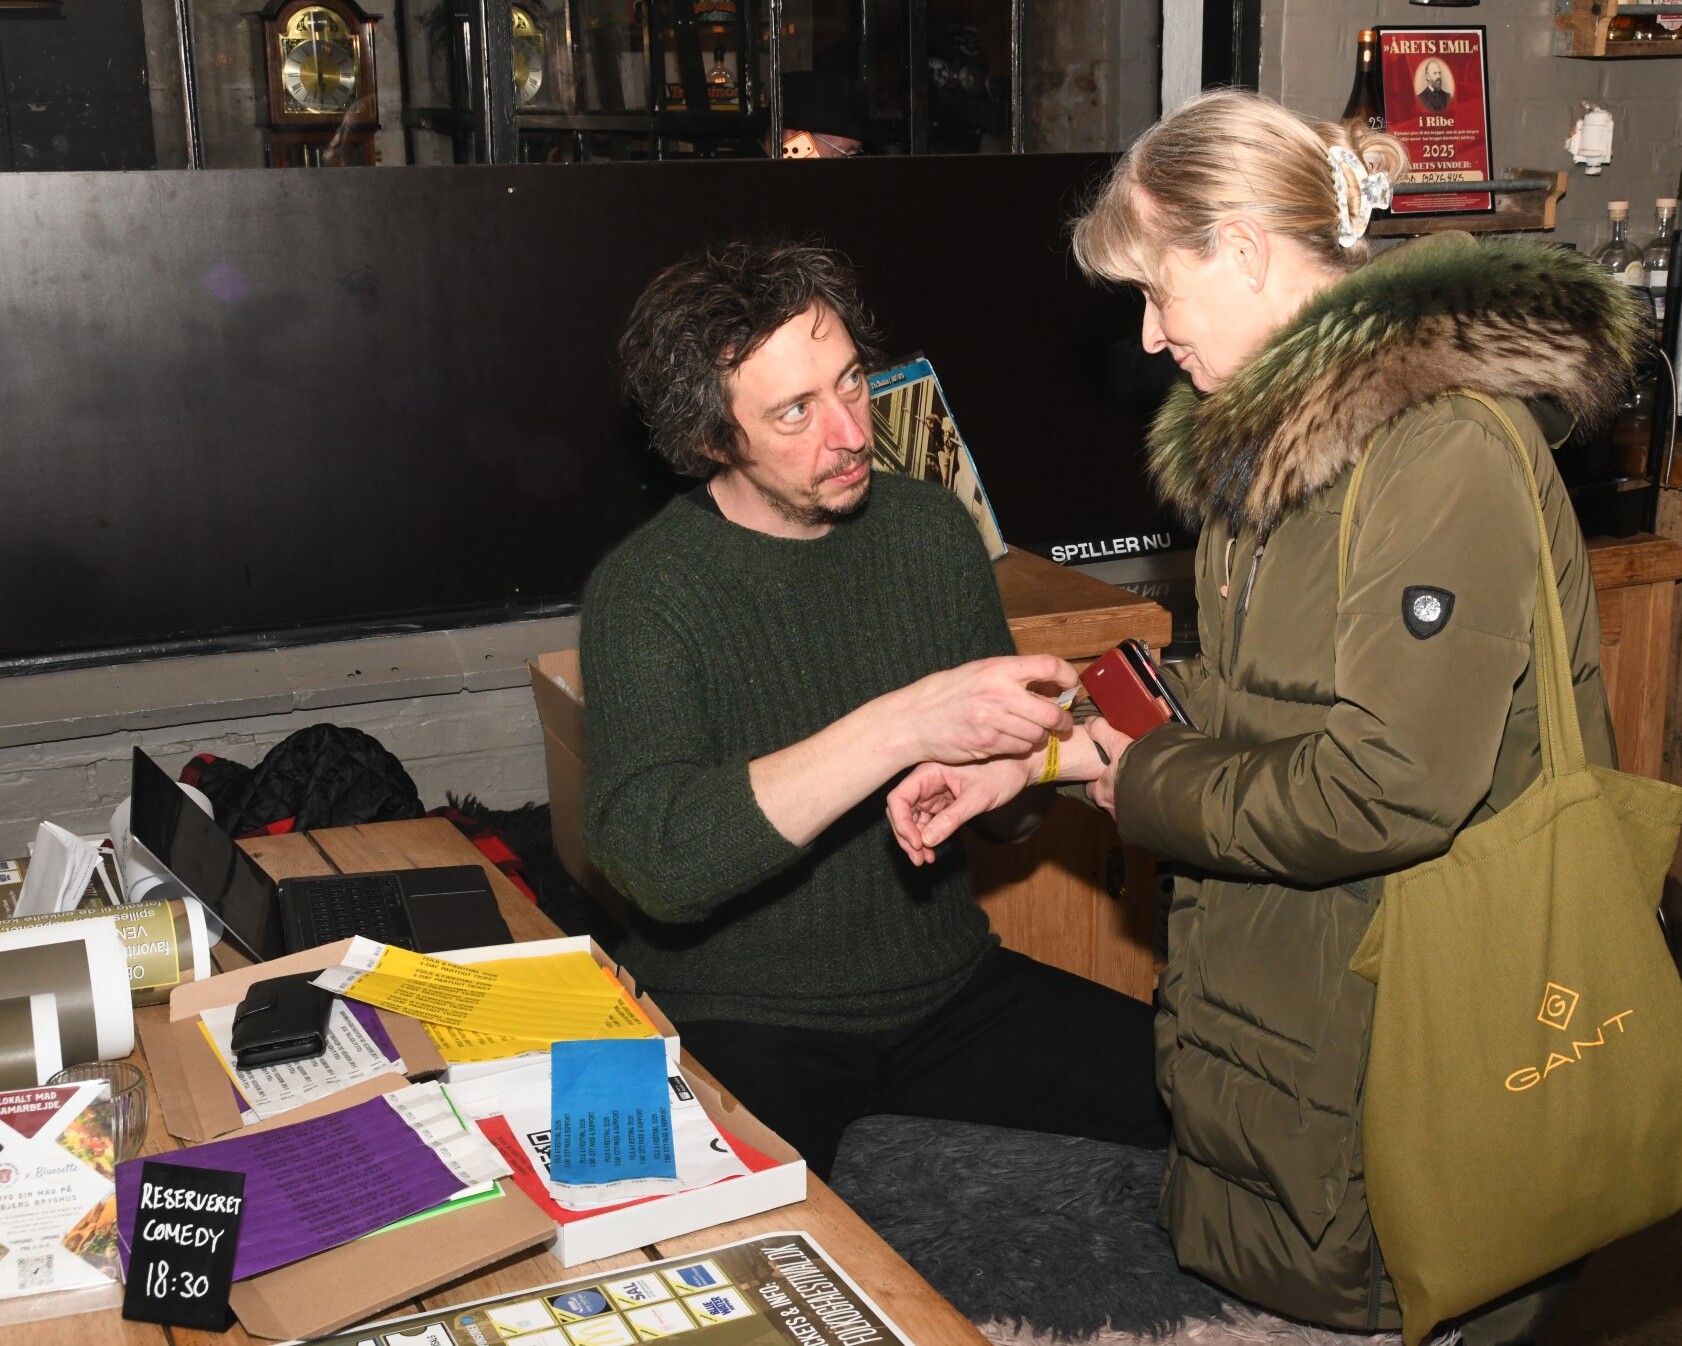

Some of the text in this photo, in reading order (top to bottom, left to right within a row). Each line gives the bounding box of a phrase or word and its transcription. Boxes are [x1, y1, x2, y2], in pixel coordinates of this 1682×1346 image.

[1426, 116, 1455, 127] Ribe
[1422, 144, 1455, 158] 2025
[1437, 161, 1472, 169] VINDER:
[1051, 532, 1171, 562] SPILLER NU
[24, 911, 74, 922] enkelte
[101, 906, 112, 914] til
[114, 908, 155, 922] spilles
[441, 966, 471, 977] PARTOUT
[473, 974, 497, 982] TICKET
[1505, 1009, 1633, 1092] GANT
[35, 1091, 57, 1100] MAD
[0, 1101, 61, 1115] AMARBEJDE
[38, 1188, 56, 1196] MAD
[60, 1184, 72, 1193] PÅ
[34, 1194, 77, 1206] BRYGHUS
[140, 1182, 242, 1215] RESERVERET
[142, 1219, 225, 1254] COMEDY
[146, 1260, 209, 1299] 18:30
[622, 1282, 646, 1301] SAL
[702, 1302, 720, 1316] BLUE
[710, 1296, 731, 1316] WATER
[758, 1282, 830, 1346] CKETS & INFO:
